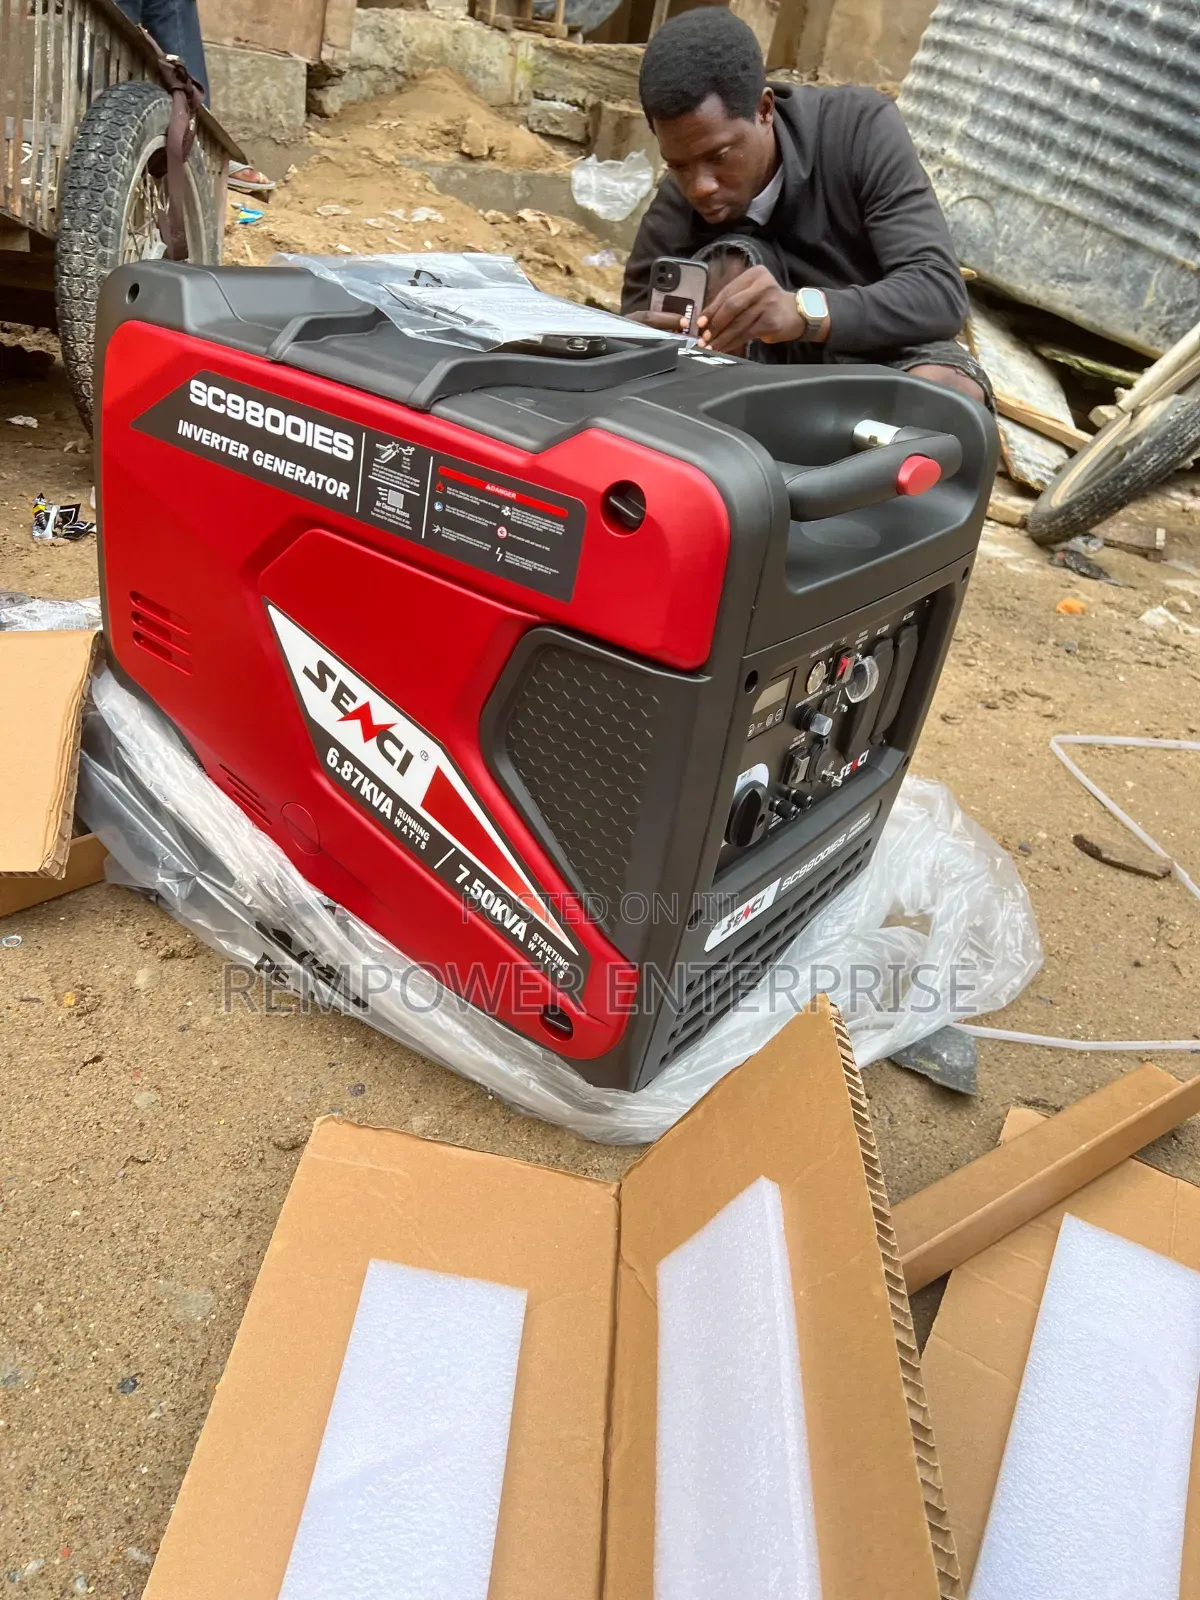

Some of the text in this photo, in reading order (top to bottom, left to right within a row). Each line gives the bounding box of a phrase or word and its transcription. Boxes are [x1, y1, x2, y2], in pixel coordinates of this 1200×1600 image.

[190, 379, 354, 461] SC9800IES
[177, 419, 249, 461] INVERTER
[252, 450, 351, 500] GENERATOR
[491, 485, 517, 499] DANGER
[302, 660, 415, 777] SENCI
[326, 747, 394, 819] 6.87KVA
[394, 818, 427, 850] WATTS
[397, 808, 430, 841] RUNNING
[455, 864, 527, 942] 7.50KVA
[527, 940, 565, 979] WATTS
[532, 933, 570, 970] STARTING
